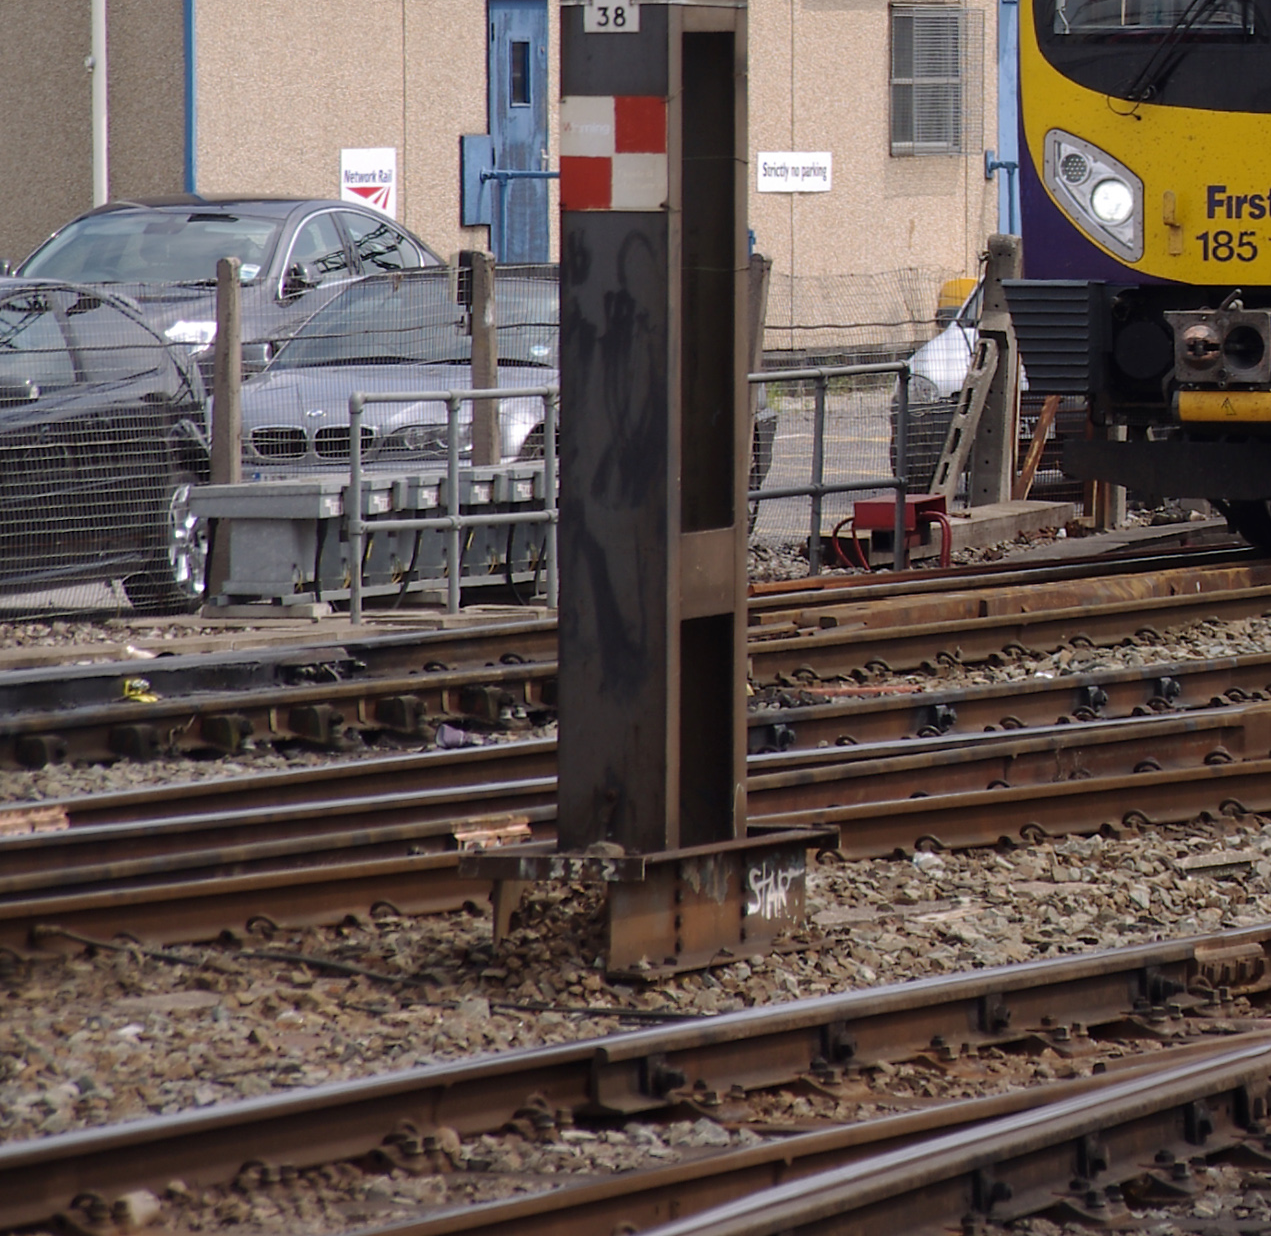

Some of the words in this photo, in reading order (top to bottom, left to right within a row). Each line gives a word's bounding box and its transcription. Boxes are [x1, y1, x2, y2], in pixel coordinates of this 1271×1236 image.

[596, 5, 627, 28] 38
[343, 168, 377, 184] Network
[378, 168, 393, 184] Rail
[762, 161, 790, 182] Strictly
[791, 166, 800, 178] no
[801, 161, 828, 182] parking
[1195, 229, 1259, 263] 185
